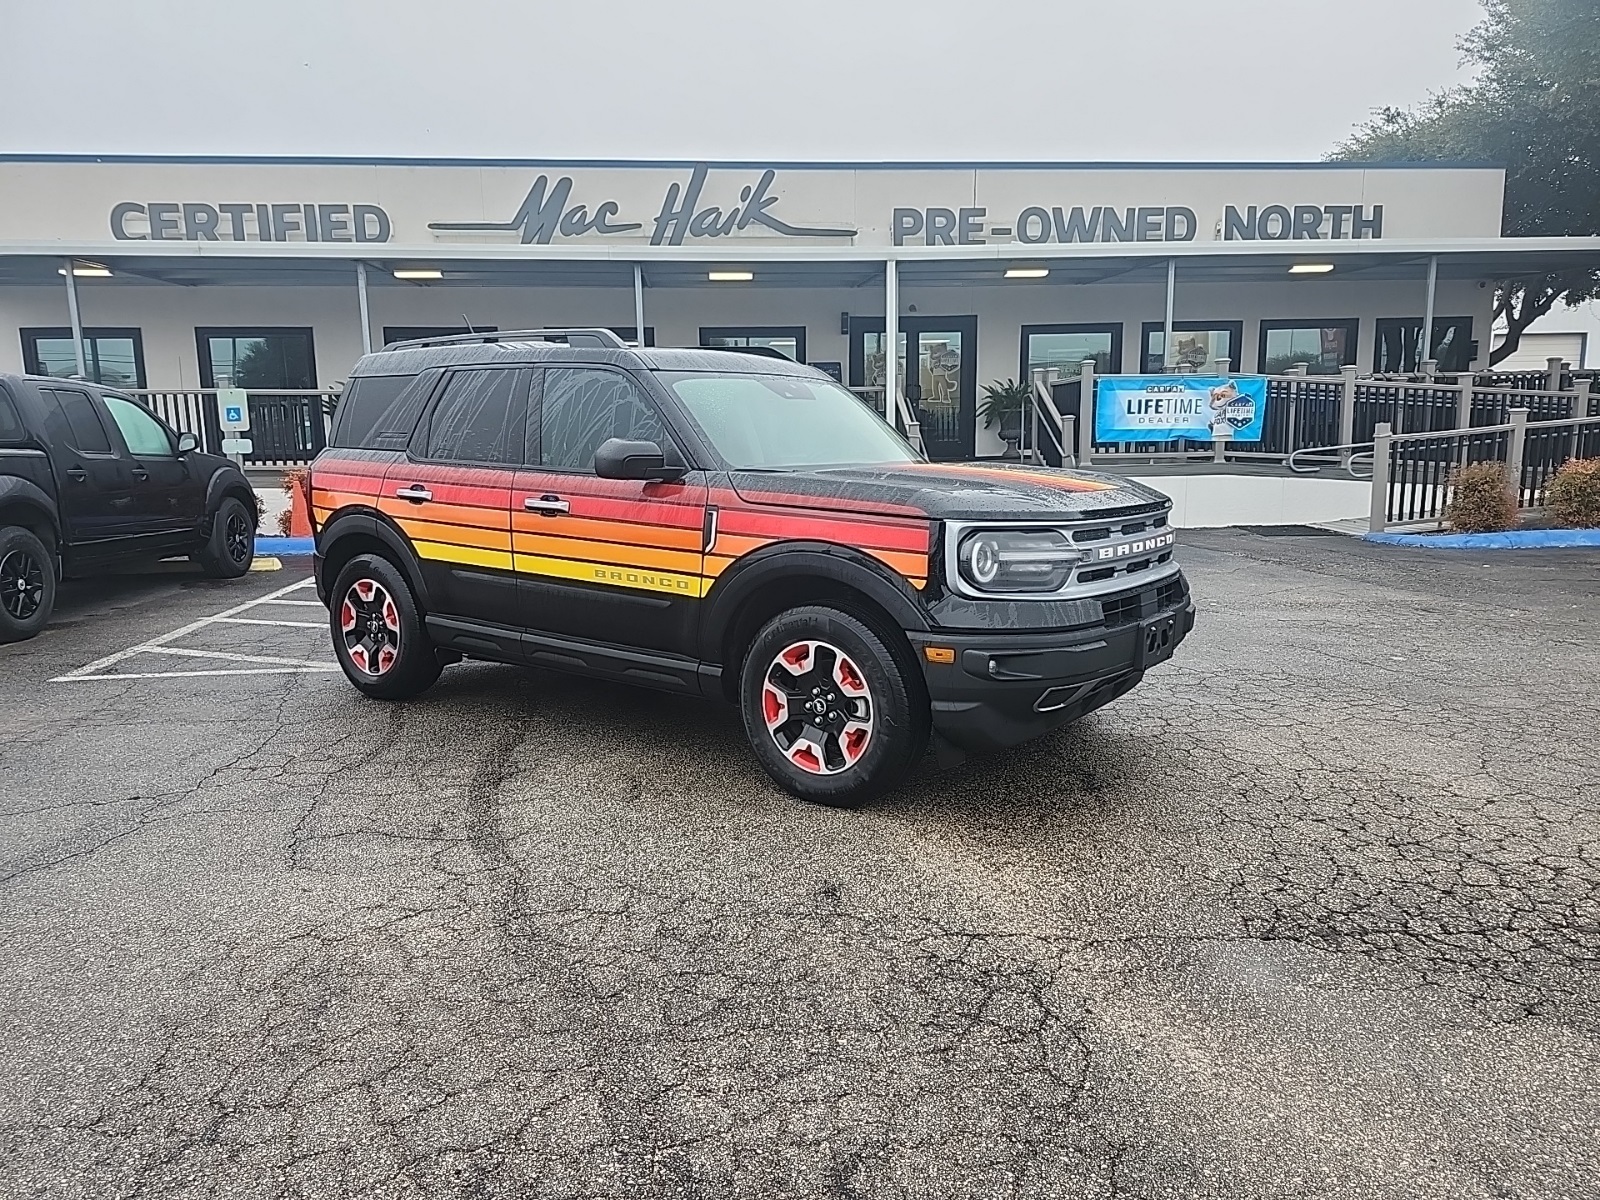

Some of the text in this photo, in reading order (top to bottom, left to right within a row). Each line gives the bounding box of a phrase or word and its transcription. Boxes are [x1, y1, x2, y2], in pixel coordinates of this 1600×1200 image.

[427, 163, 858, 245] Mac Haik
[110, 201, 391, 243] CERTIFIED
[892, 204, 1383, 245] PRE-OWNED NORTH
[1146, 385, 1185, 393] CARFAX
[1127, 399, 1202, 415] LIFETIME
[1099, 534, 1173, 559] BRONCO
[595, 569, 689, 589] BRONCO
